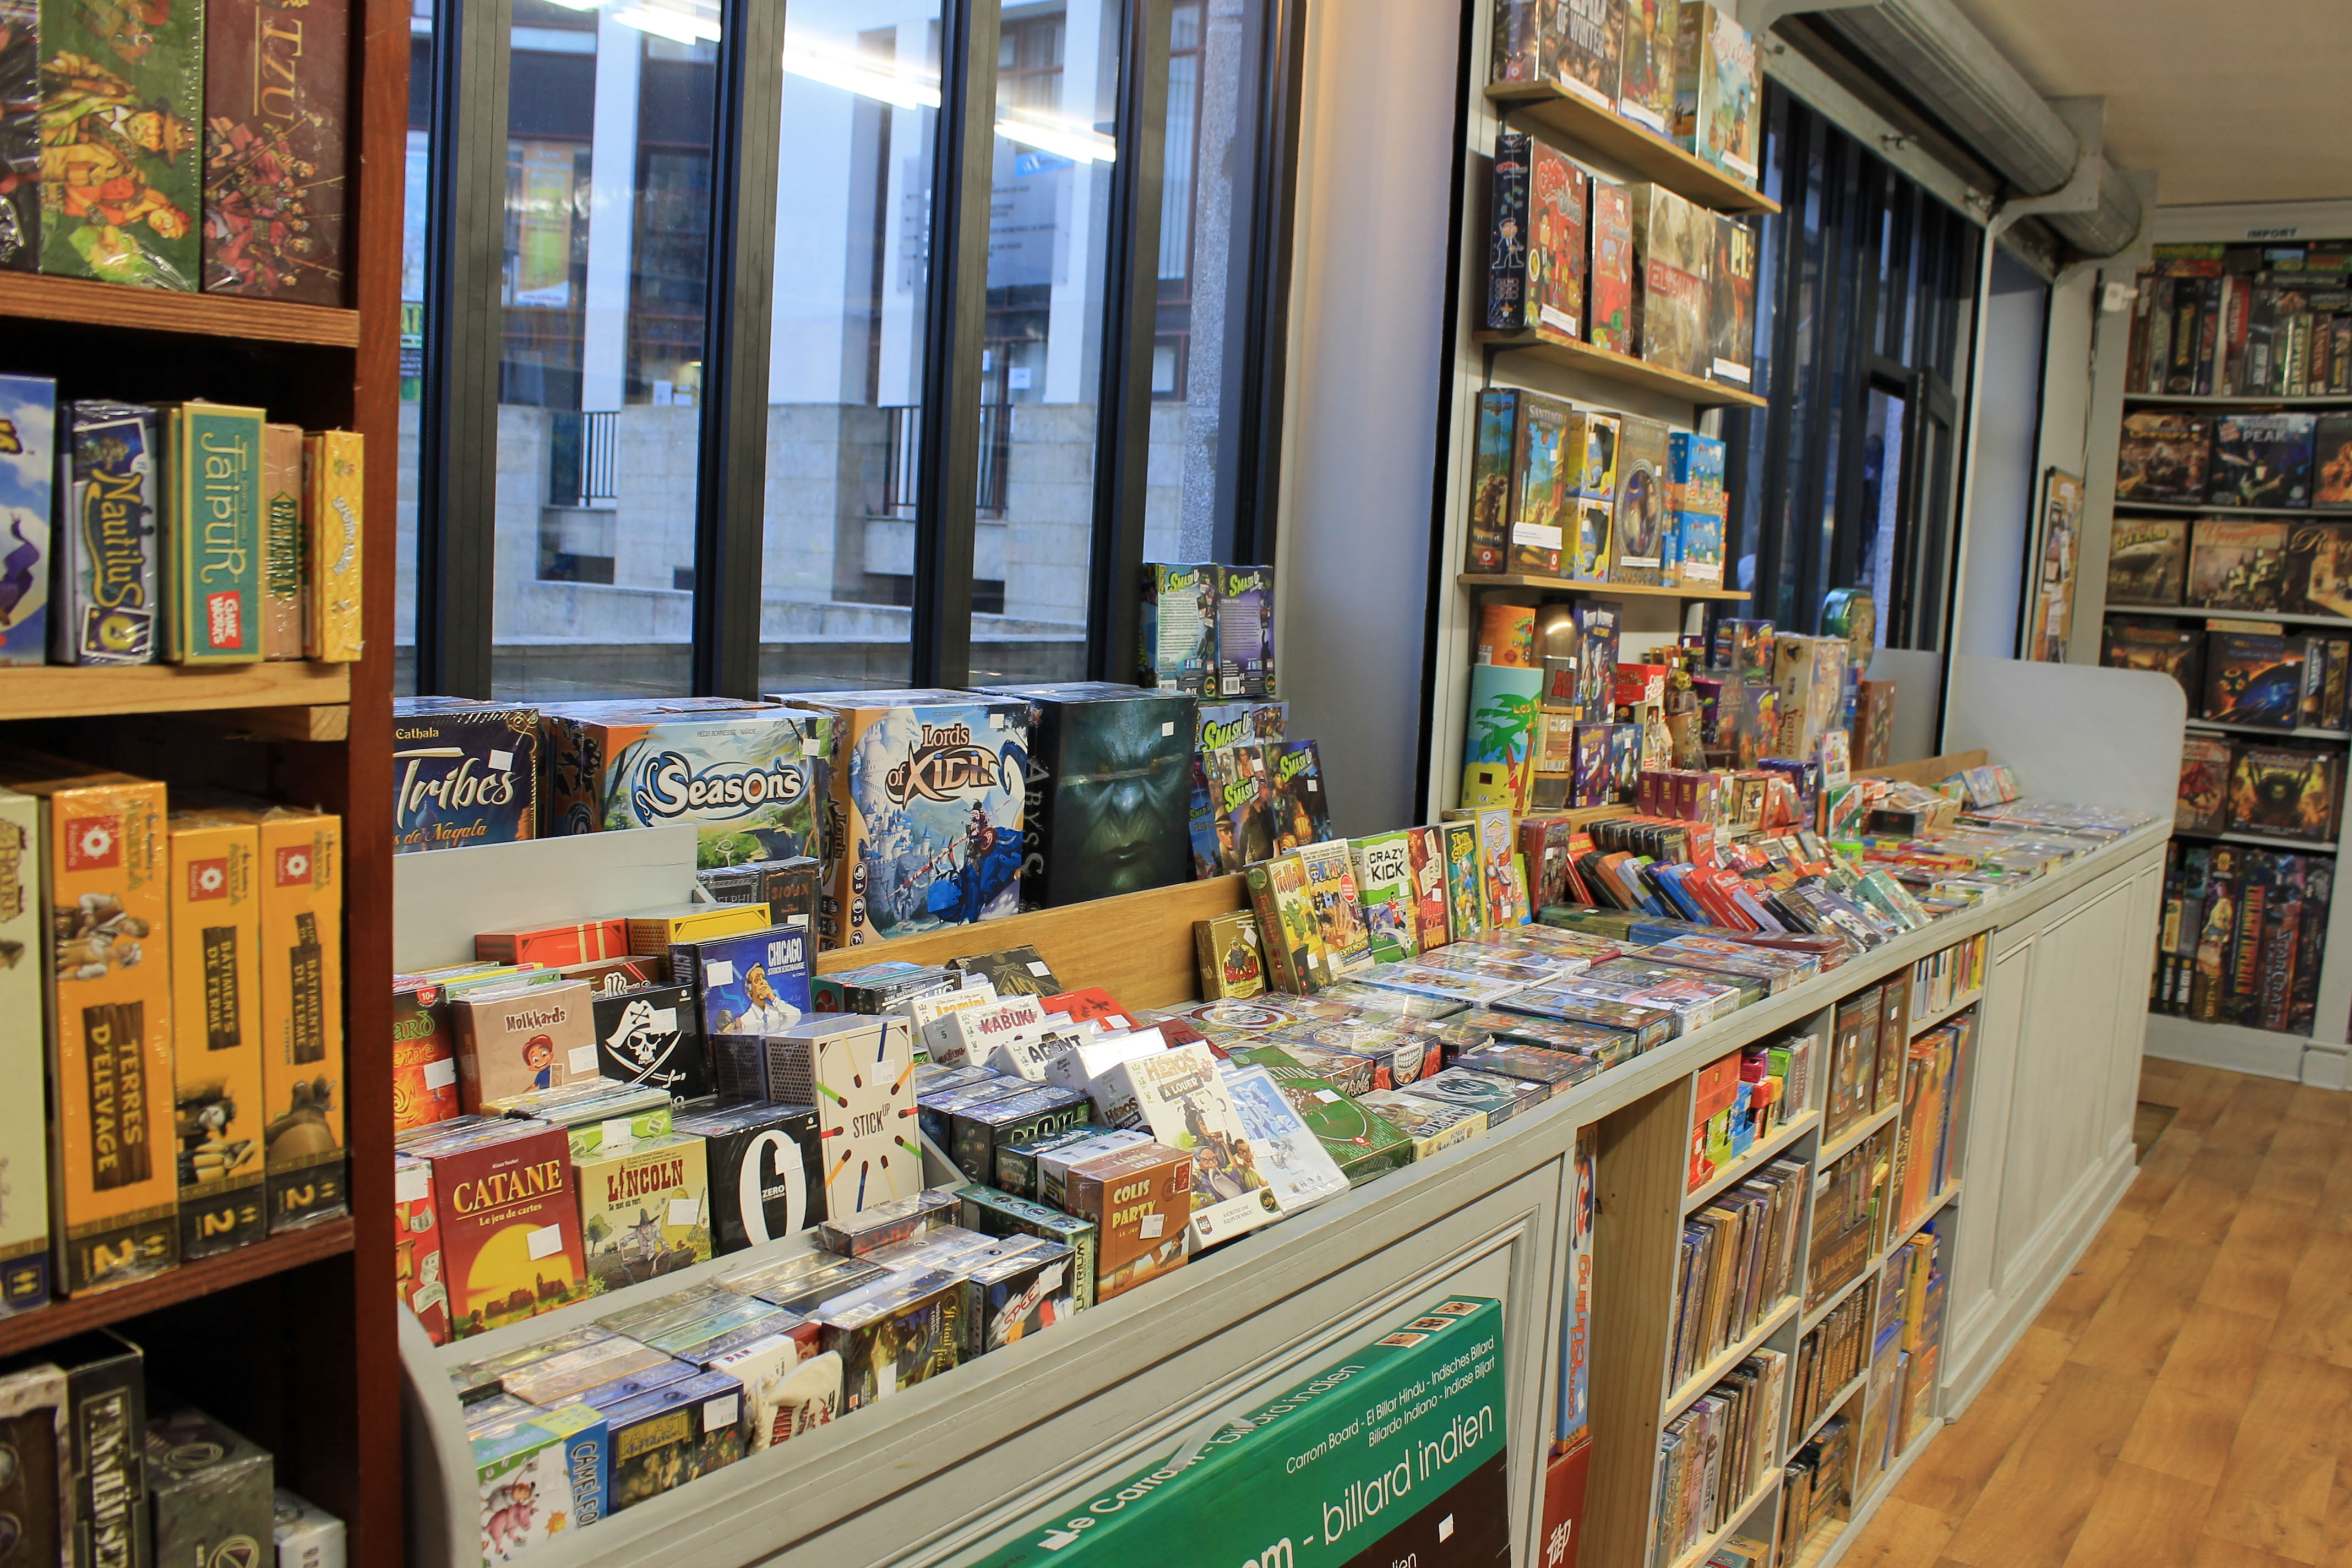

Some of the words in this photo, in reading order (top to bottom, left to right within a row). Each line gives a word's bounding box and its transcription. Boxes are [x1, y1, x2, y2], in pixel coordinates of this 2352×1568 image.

[1570, 8, 1605, 58] WINTER
[262, 19, 303, 121] TZU
[2247, 228, 2297, 238] IMPORT
[1168, 571, 1194, 592] SMASH
[1229, 574, 1254, 597] SMASH
[210, 596, 225, 646] WORKS
[224, 597, 237, 638] GAME
[396, 727, 439, 741] Cathala
[922, 723, 970, 748] Lords
[1201, 719, 1243, 750] SMASH
[888, 764, 905, 788] of
[1279, 754, 1306, 783] SMASH
[394, 747, 519, 830] Tribes
[650, 753, 804, 815] Seasons
[1224, 780, 1253, 813] SMASH
[1369, 847, 1405, 864] CRAZY
[1370, 863, 1406, 883] KICK
[853, 914, 863, 923] 3-5
[207, 946, 217, 969] DE
[767, 937, 803, 968] CHICAGO
[220, 940, 233, 1034] BÂTIMENTS
[293, 965, 303, 987] DE
[209, 972, 220, 1033] FERME
[304, 959, 319, 1047] BÂTIMENTS
[421, 992, 435, 1000] 10+
[294, 989, 306, 1047] FERME
[505, 1006, 566, 1032] Mölkkards
[980, 1008, 1037, 1035] KABUKI
[941, 1031, 948, 1039] 5
[1143, 1048, 1198, 1082] HÉROS
[91, 1025, 119, 1172] D'ÉLEVAGE
[119, 1038, 144, 1146] TERRES
[1171, 1076, 1199, 1093] LOUER
[852, 1110, 884, 1139] STICK
[883, 1103, 890, 1118] UP
[453, 1159, 564, 1214] CATANE
[607, 1159, 683, 1202] LINCOLN
[761, 1184, 785, 1199] ZERO
[1113, 1179, 1151, 1205] COLIS
[285, 1184, 316, 1210] 2
[204, 1208, 235, 1237] 2
[479, 1216, 490, 1227] Le
[491, 1214, 505, 1225] jeu
[506, 1209, 516, 1219] de
[518, 1204, 543, 1216] cartes
[1112, 1200, 1157, 1229] PARTY
[1199, 1220, 1210, 1231] AEG
[93, 1239, 135, 1273] 2
[1293, 1364, 1365, 1403] indien
[1287, 1440, 1327, 1474] Carrom
[1329, 1420, 1359, 1451] Board
[1367, 1409, 1375, 1427] El
[1376, 1395, 1397, 1423] Billar
[1399, 1380, 1425, 1407] Hindu
[1431, 1353, 1470, 1385] Indisches
[1471, 1335, 1495, 1360] Billard
[1368, 1418, 1402, 1448] Biliardo
[1403, 1393, 1438, 1427] Indiano
[1444, 1374, 1474, 1401] Indiase
[1475, 1354, 1495, 1381] Biljart
[1323, 1449, 1412, 1546] billard
[1418, 1403, 1494, 1482] indien
